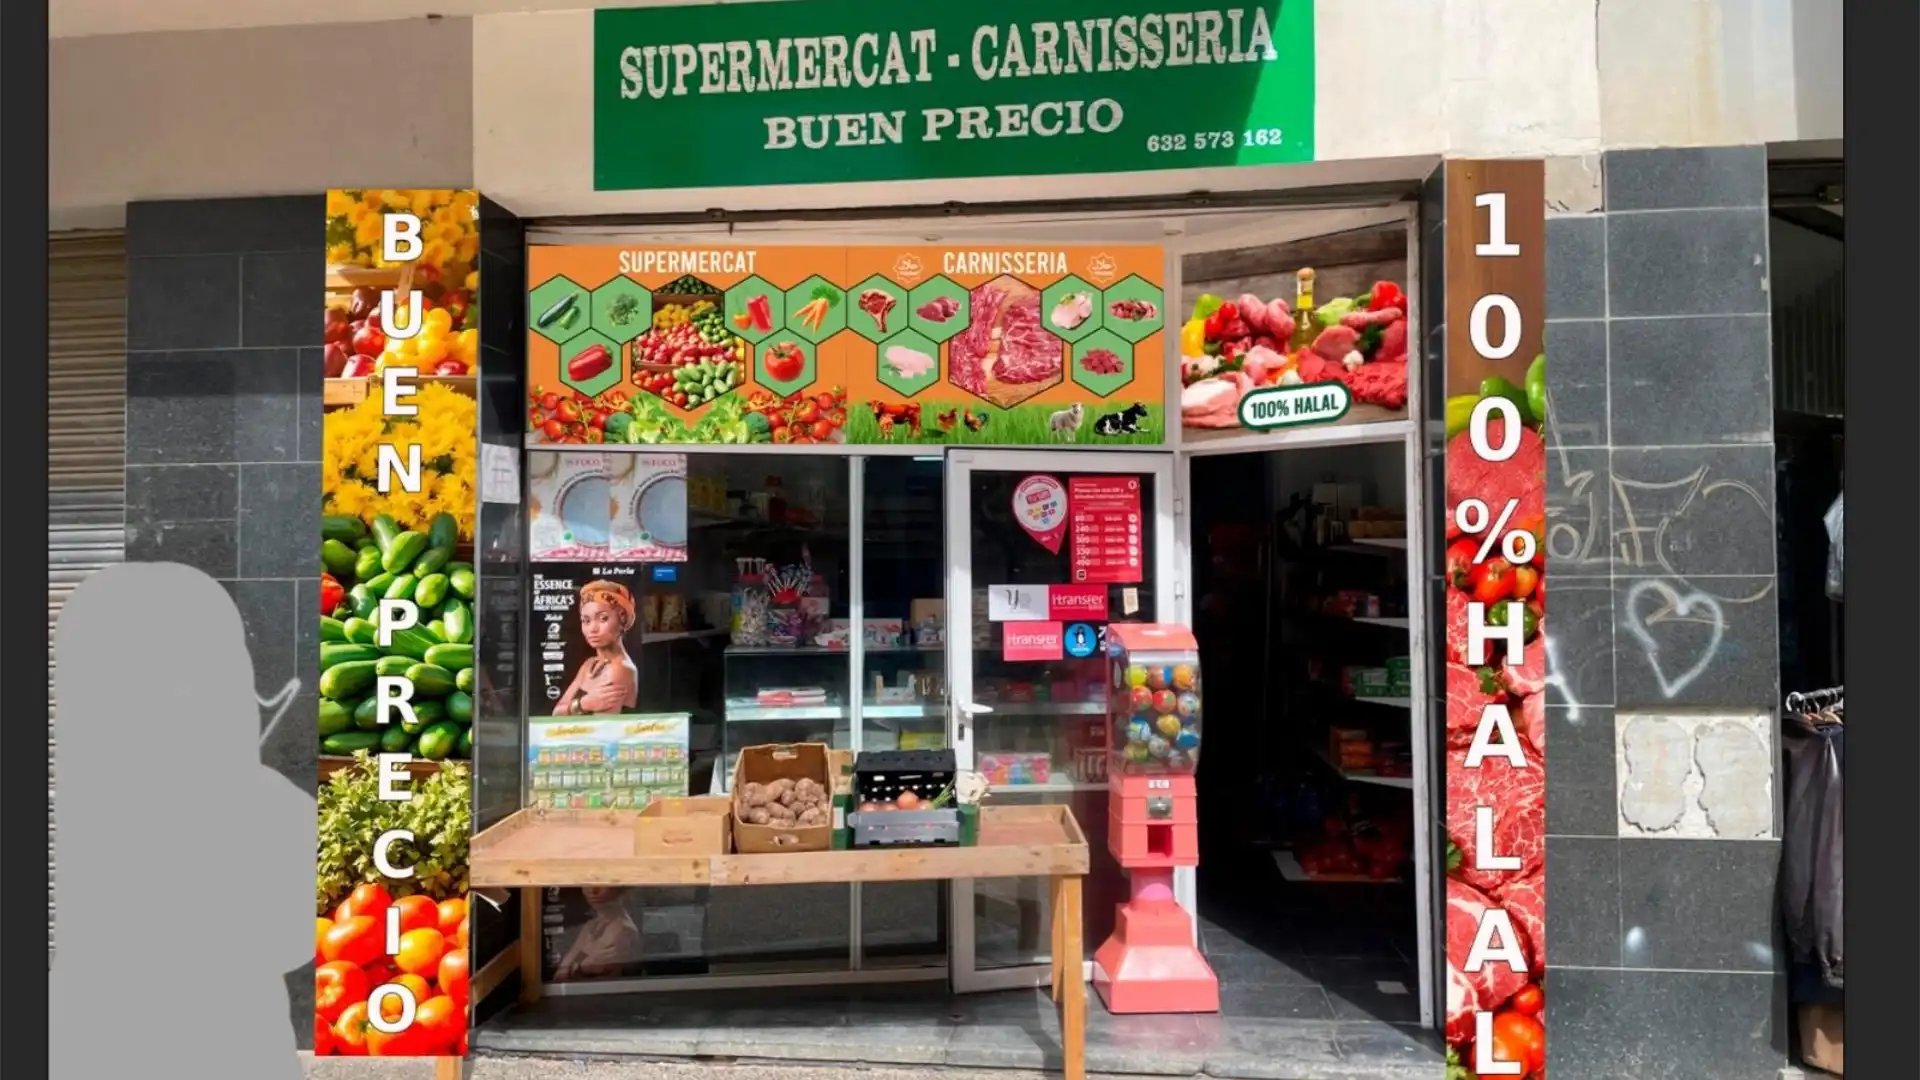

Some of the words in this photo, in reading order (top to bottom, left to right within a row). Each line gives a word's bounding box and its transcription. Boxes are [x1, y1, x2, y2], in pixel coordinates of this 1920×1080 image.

[620, 29, 936, 99] SUPERMERCAT
[971, 6, 1277, 81] CARNISSERIA
[763, 110, 906, 151] BUEN
[922, 98, 1125, 142] PRECIO
[1146, 134, 1187, 152] 632
[1194, 130, 1234, 149] 573
[1243, 128, 1283, 146] 162
[619, 250, 757, 273] SUPERMERCAT
[943, 251, 1068, 274] CARNISSERIA
[376, 212, 424, 494] BUEN
[1250, 400, 1290, 419] 100%
[1293, 393, 1340, 415] HALAL
[533, 579, 574, 590] ESSENCE
[533, 595, 575, 606] AFRICA'S
[366, 598, 420, 1035] PRECIO
